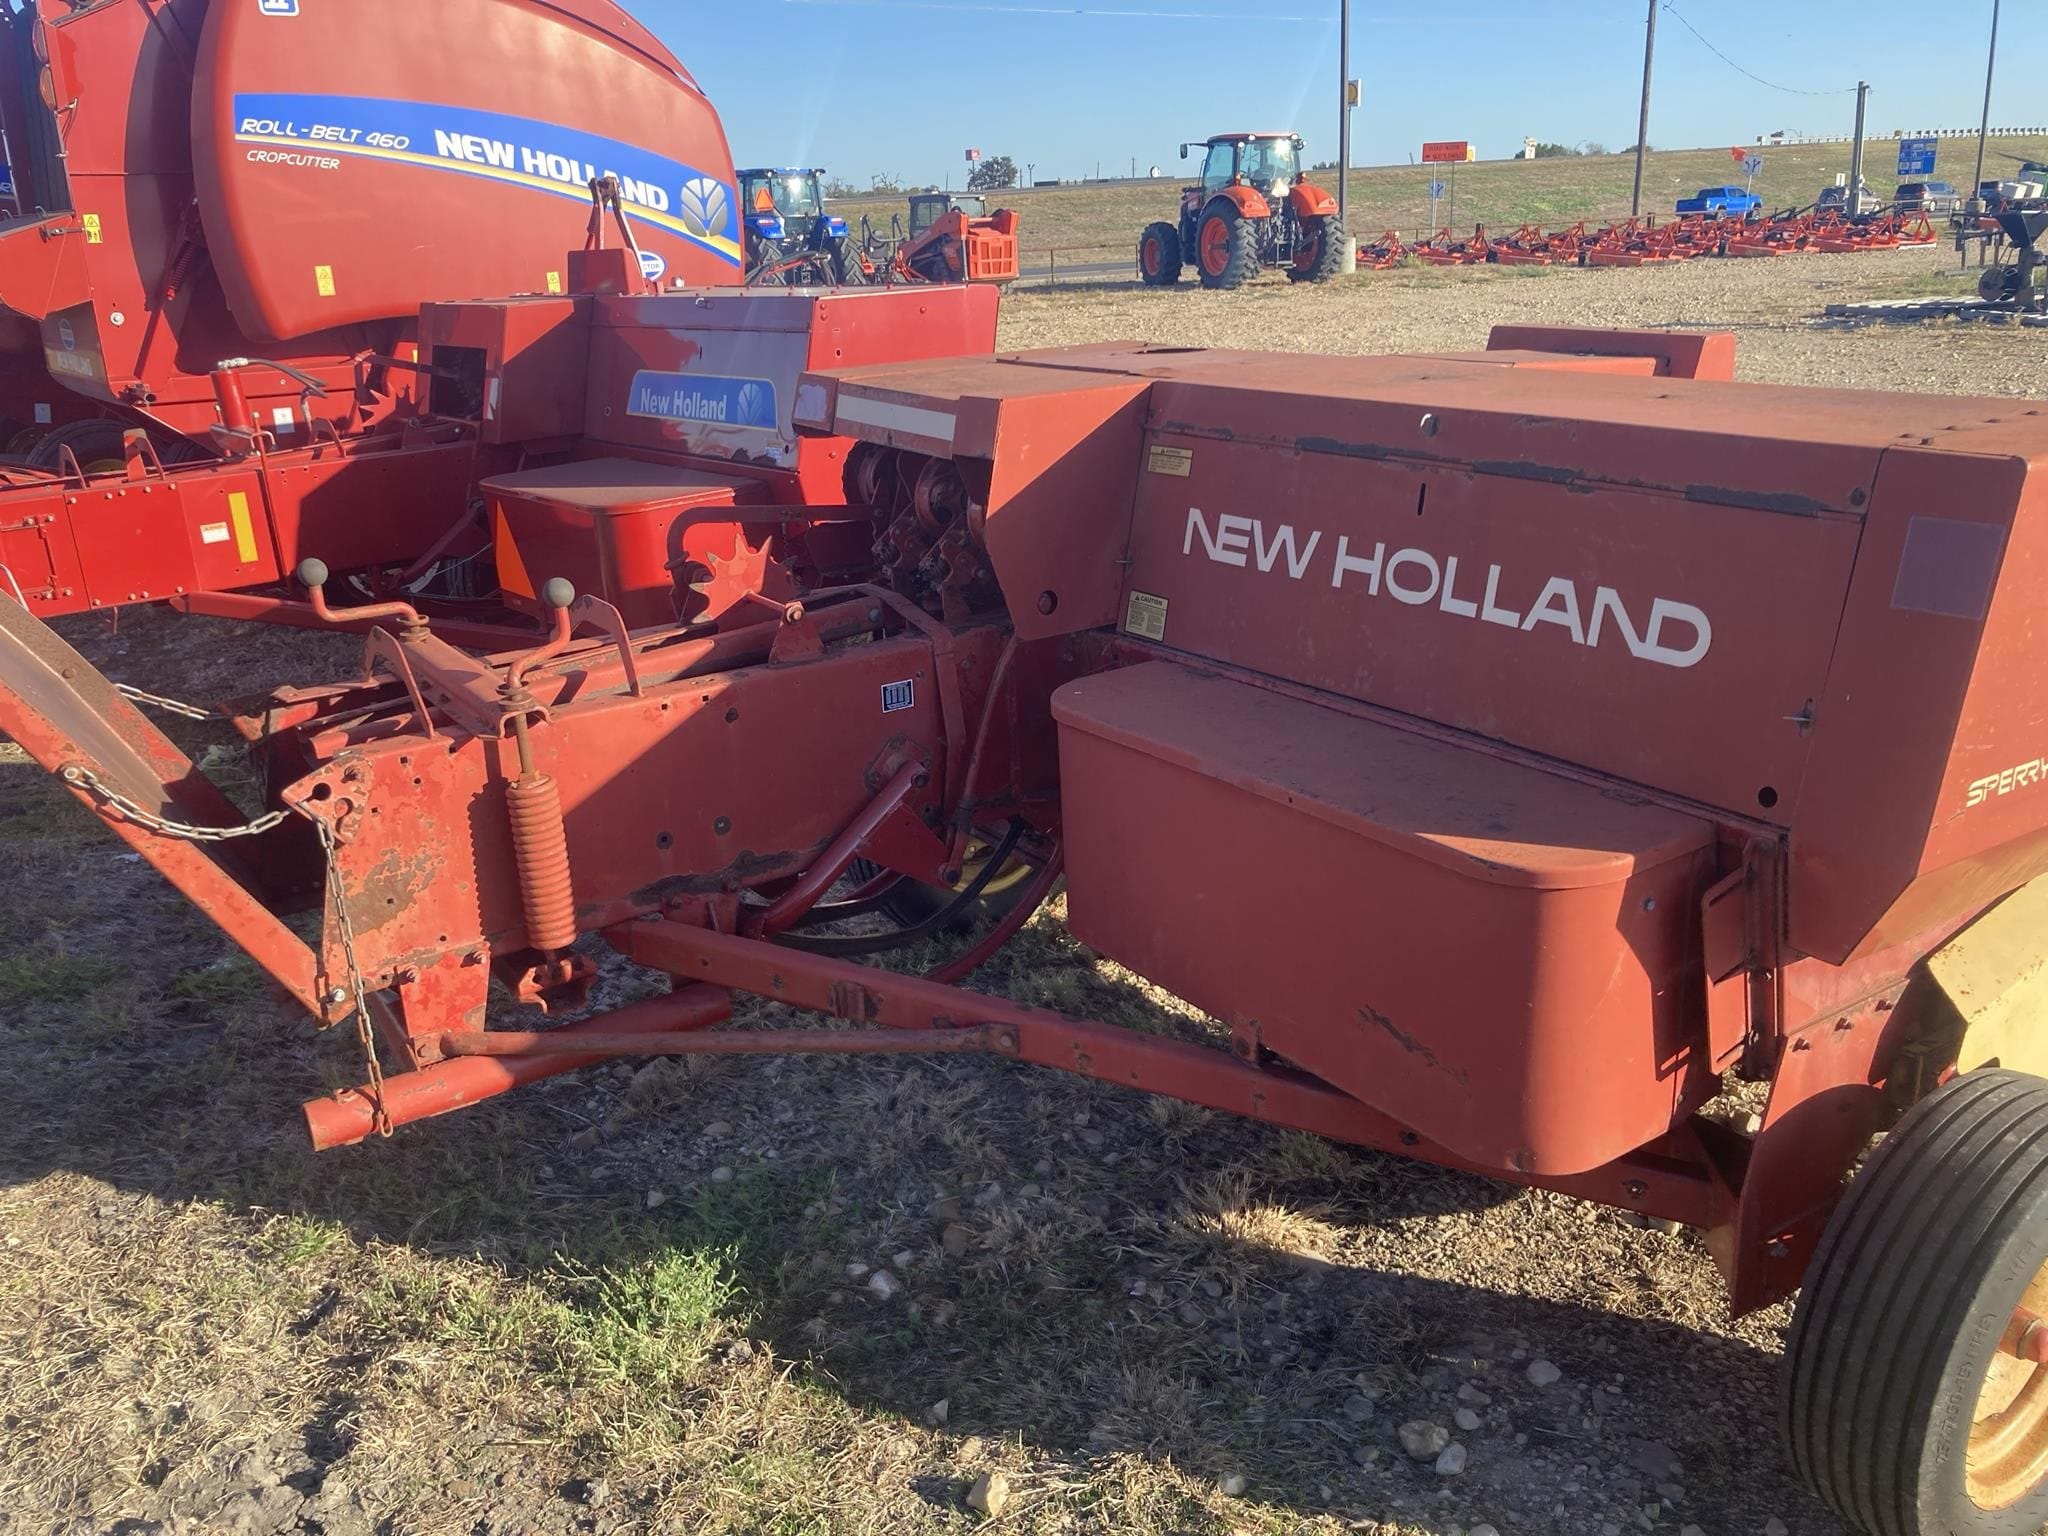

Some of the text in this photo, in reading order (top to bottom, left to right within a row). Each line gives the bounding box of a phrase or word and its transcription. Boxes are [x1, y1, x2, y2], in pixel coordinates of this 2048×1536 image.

[240, 118, 410, 150] ROLL-BELT 460
[434, 129, 515, 169] NEW
[246, 150, 340, 170] CROPCUTTER
[640, 388, 727, 421] New Holland
[1140, 596, 1162, 605] CAUTION
[1182, 507, 1712, 668] NEW HOLLAND
